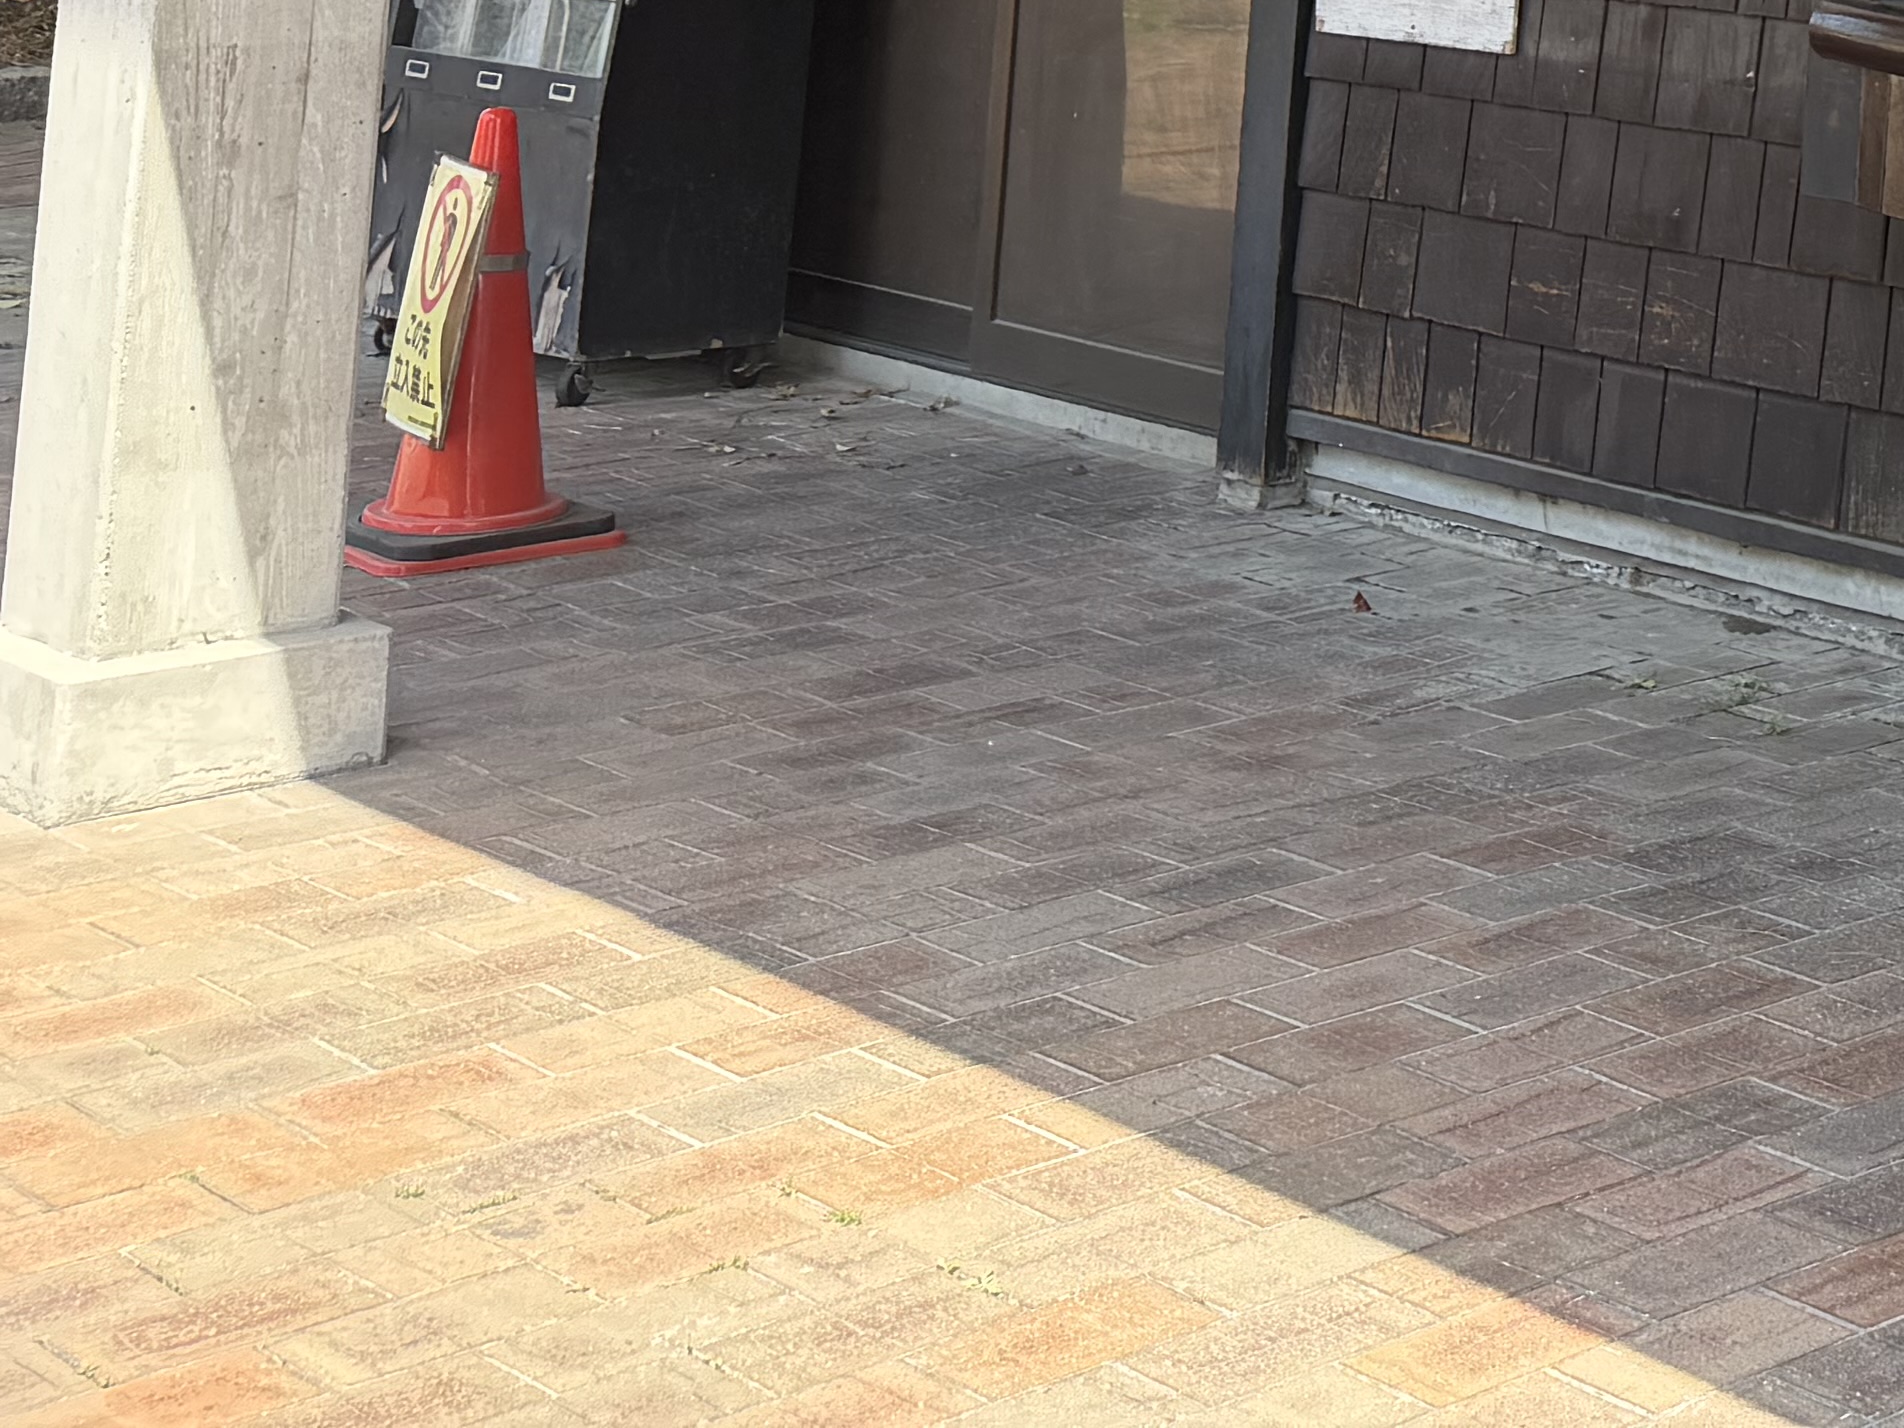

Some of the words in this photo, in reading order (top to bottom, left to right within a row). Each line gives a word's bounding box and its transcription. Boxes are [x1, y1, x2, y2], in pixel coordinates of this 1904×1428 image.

[405, 313, 431, 360] この先
[391, 352, 436, 408] 立入禁止
